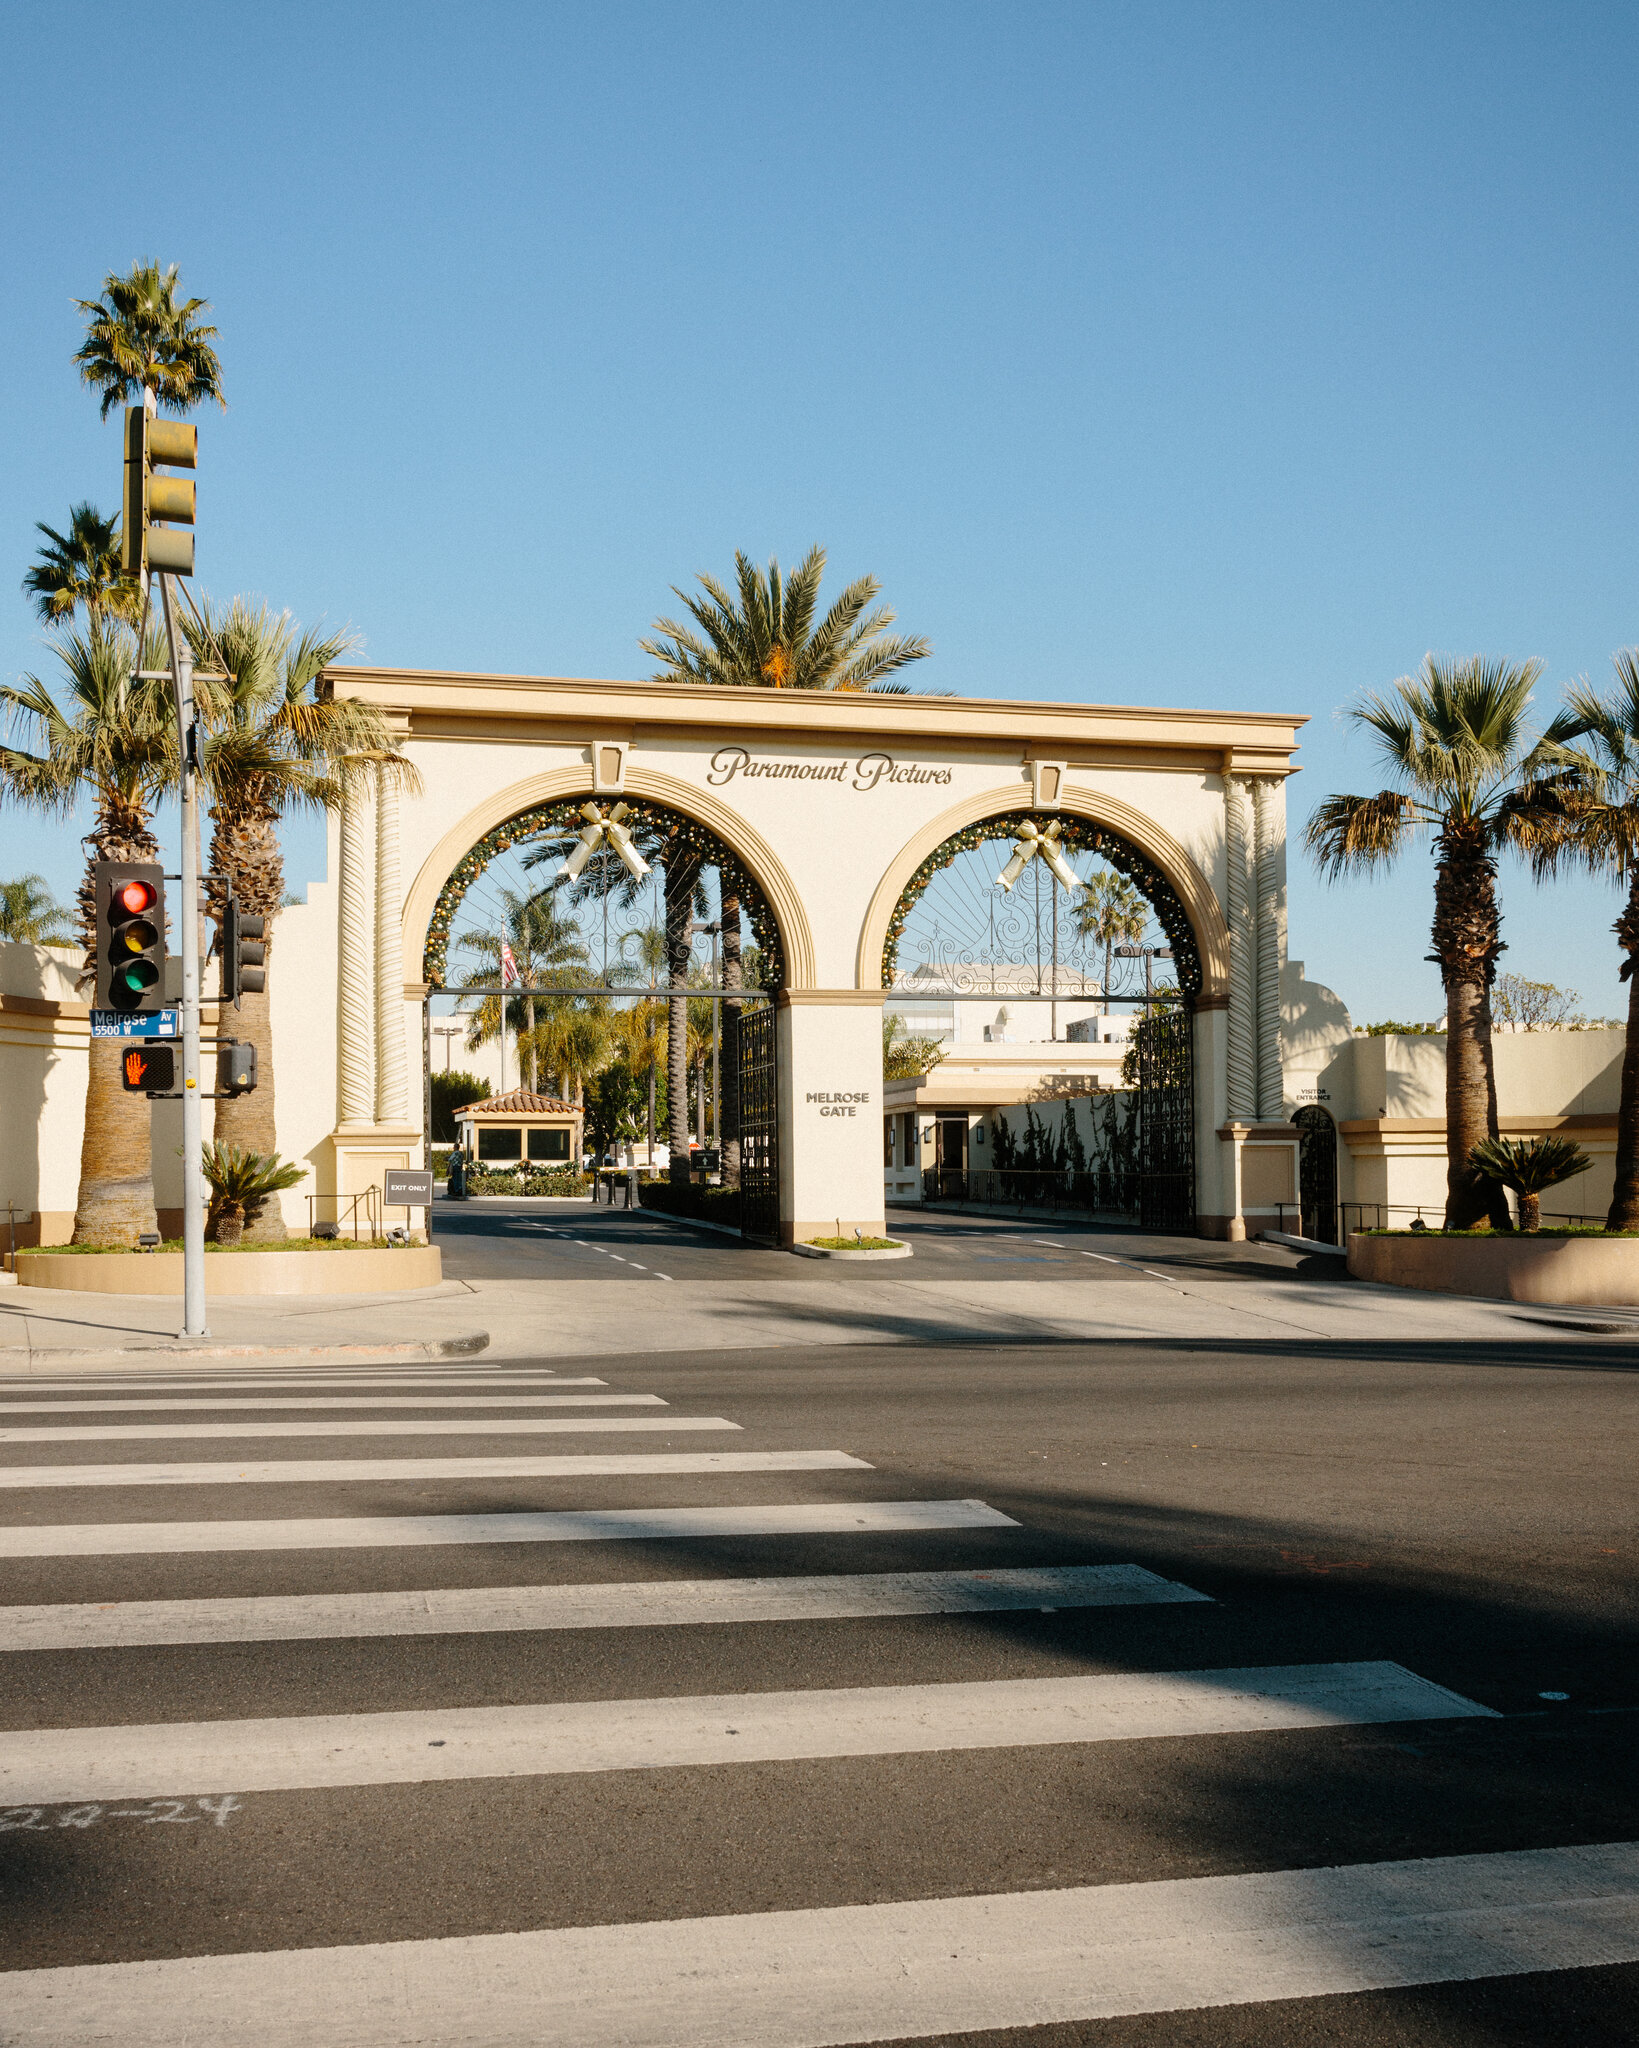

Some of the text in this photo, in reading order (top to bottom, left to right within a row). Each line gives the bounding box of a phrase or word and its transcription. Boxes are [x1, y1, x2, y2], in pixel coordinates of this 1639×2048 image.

[707, 746, 952, 791] Paramount Pictures
[95, 1011, 172, 1026] Melrose Av
[95, 1026, 132, 1036] 5500 W
[806, 1094, 869, 1103] MELROSE
[820, 1106, 856, 1117] GATE
